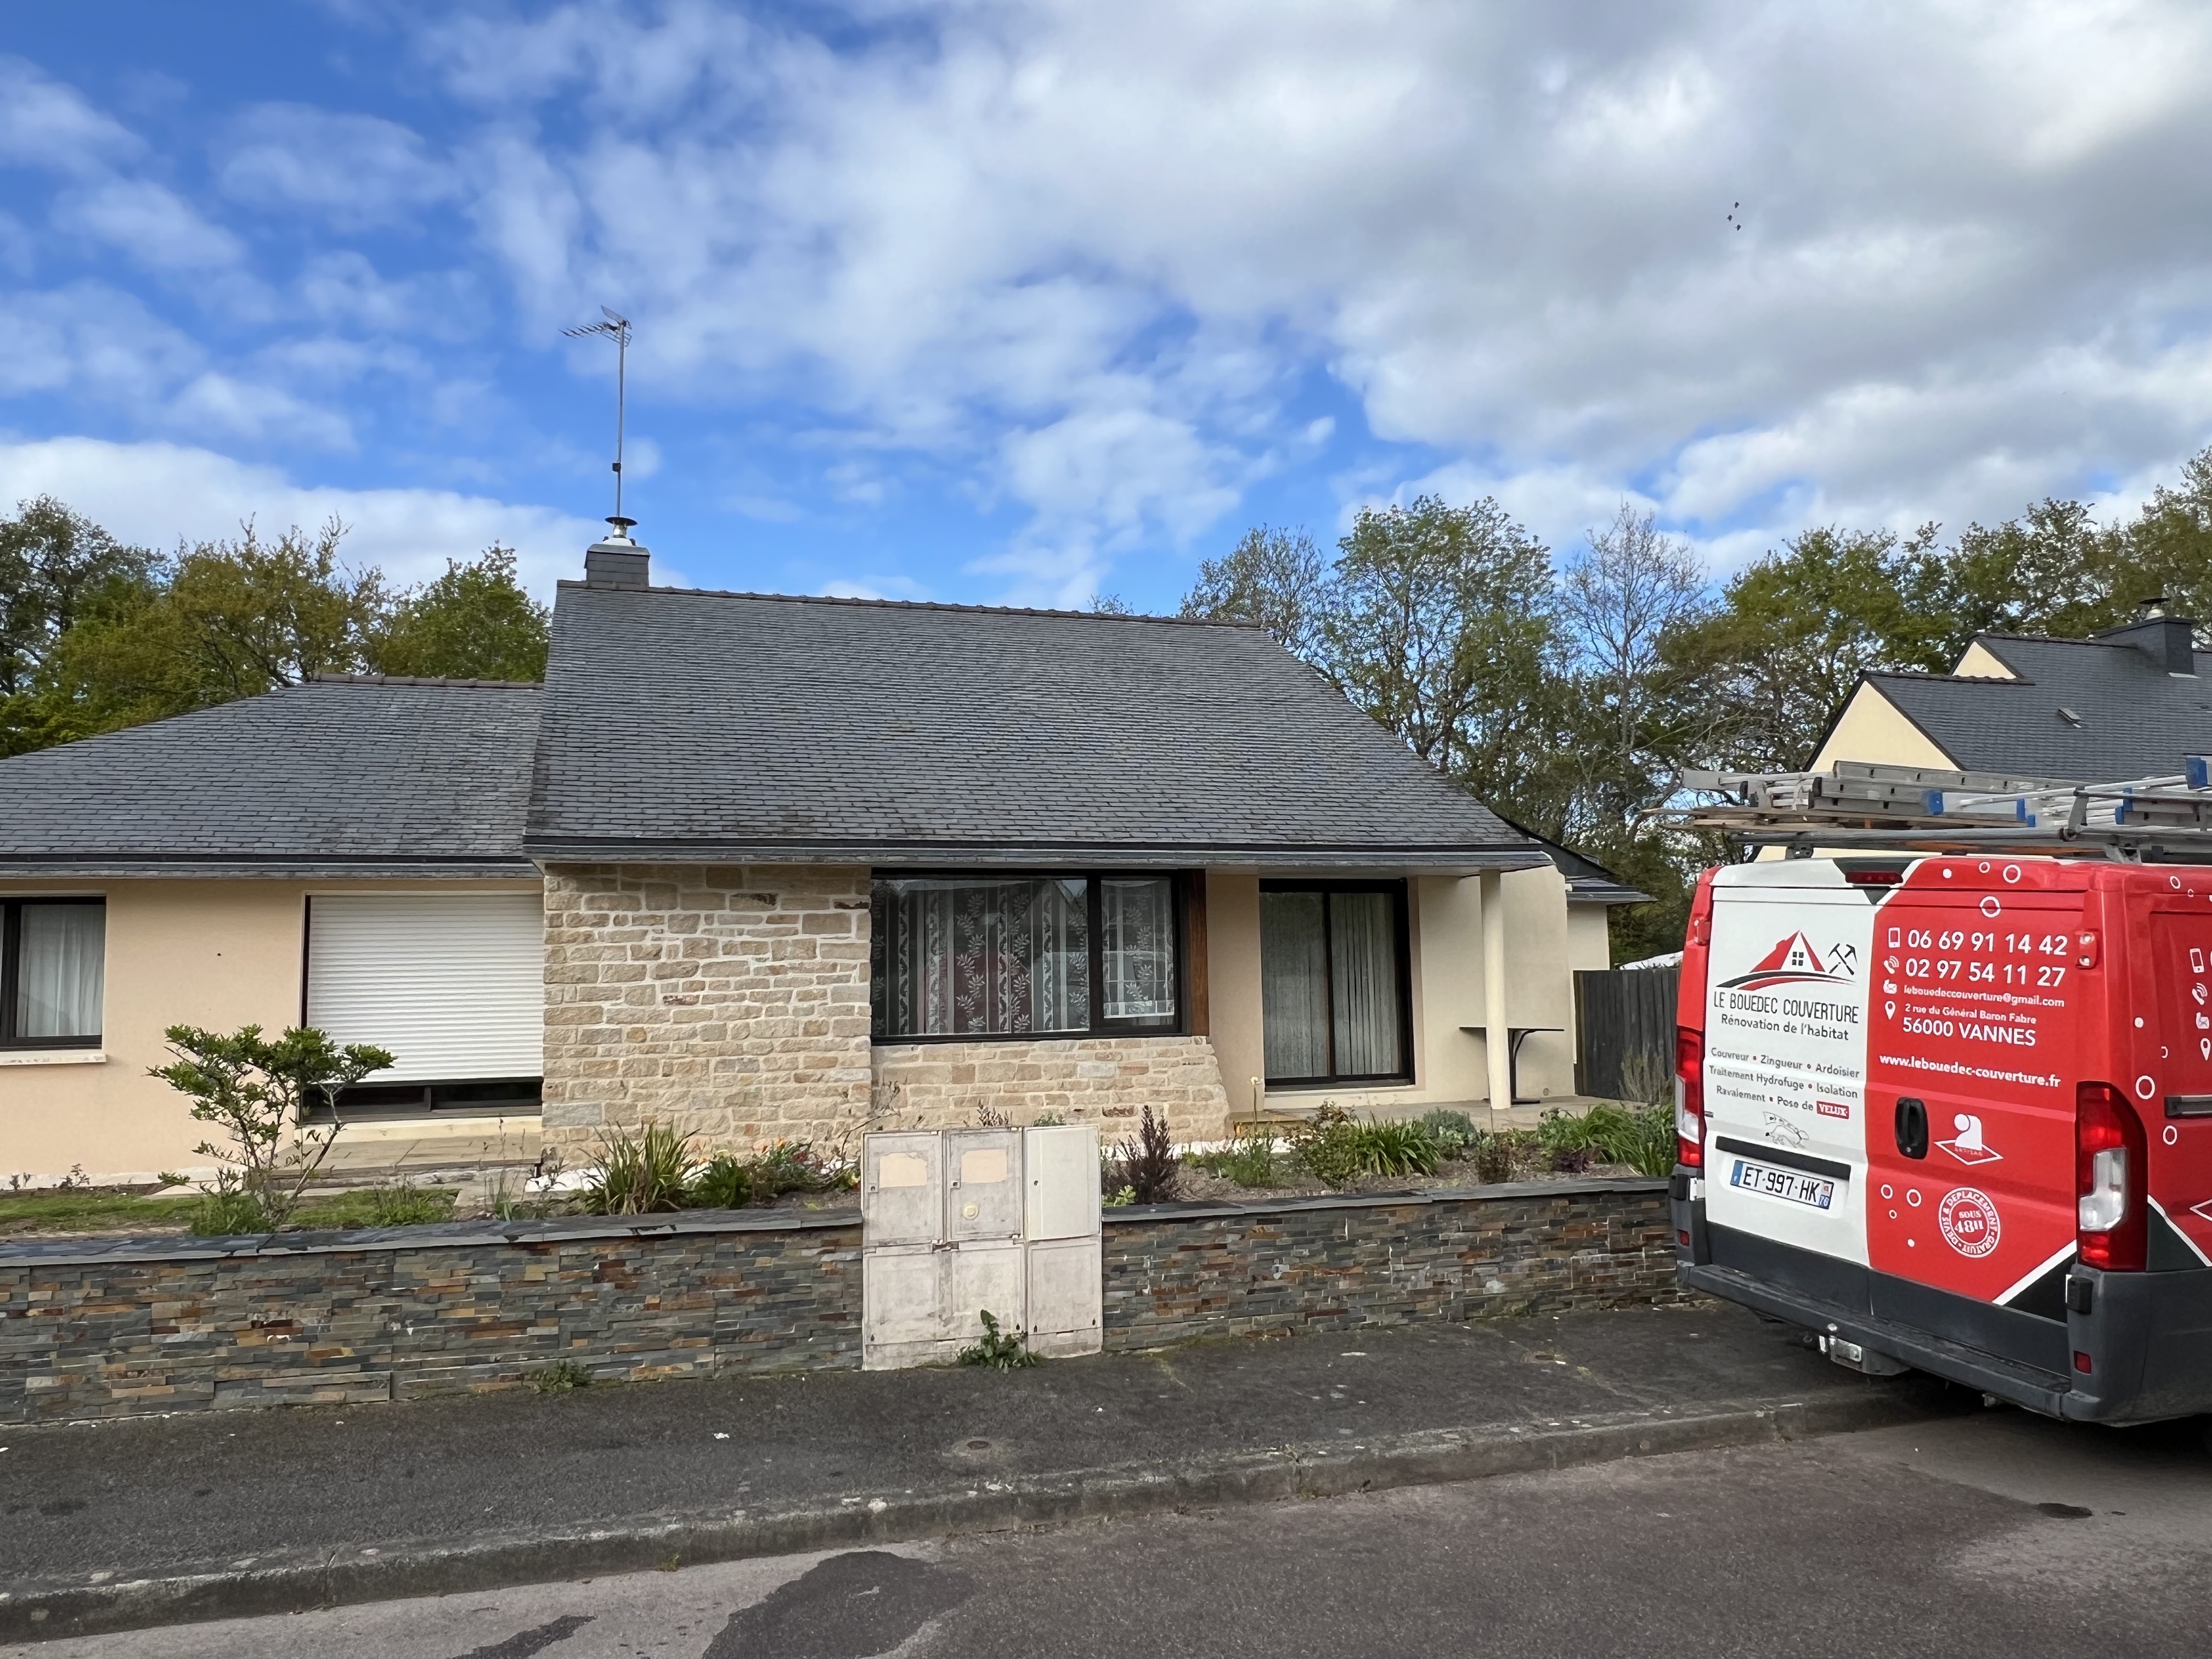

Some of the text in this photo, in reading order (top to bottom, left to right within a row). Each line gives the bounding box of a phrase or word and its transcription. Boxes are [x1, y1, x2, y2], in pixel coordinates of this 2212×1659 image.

[1908, 929, 2068, 955] 06 69 91 14 42
[1905, 958, 2066, 986] 02 97 54 11 27
[1714, 991, 1859, 1023] LE BOUEDEC COUVERTURE
[1904, 985, 2064, 1007] lebouedeccouverture@gmail.com
[1721, 1014, 1779, 1031] Rénovation
[1783, 1022, 1797, 1034] de
[1905, 1003, 1910, 1012] 2
[1929, 1006, 1940, 1015] du
[1943, 1007, 1977, 1018] Général
[1980, 1011, 2006, 1021] Baron
[1903, 1017, 2036, 1046] 56000 VANNES
[1711, 1048, 1860, 1078] Couvreur Zingueur Ardoisier
[1880, 1055, 2061, 1087] www.lebouedec-couverture.fr
[1709, 1065, 1858, 1098] Traitement Hydrofuge Isolation
[1717, 1085, 1848, 1116] Ravalement Pose de VELUX
